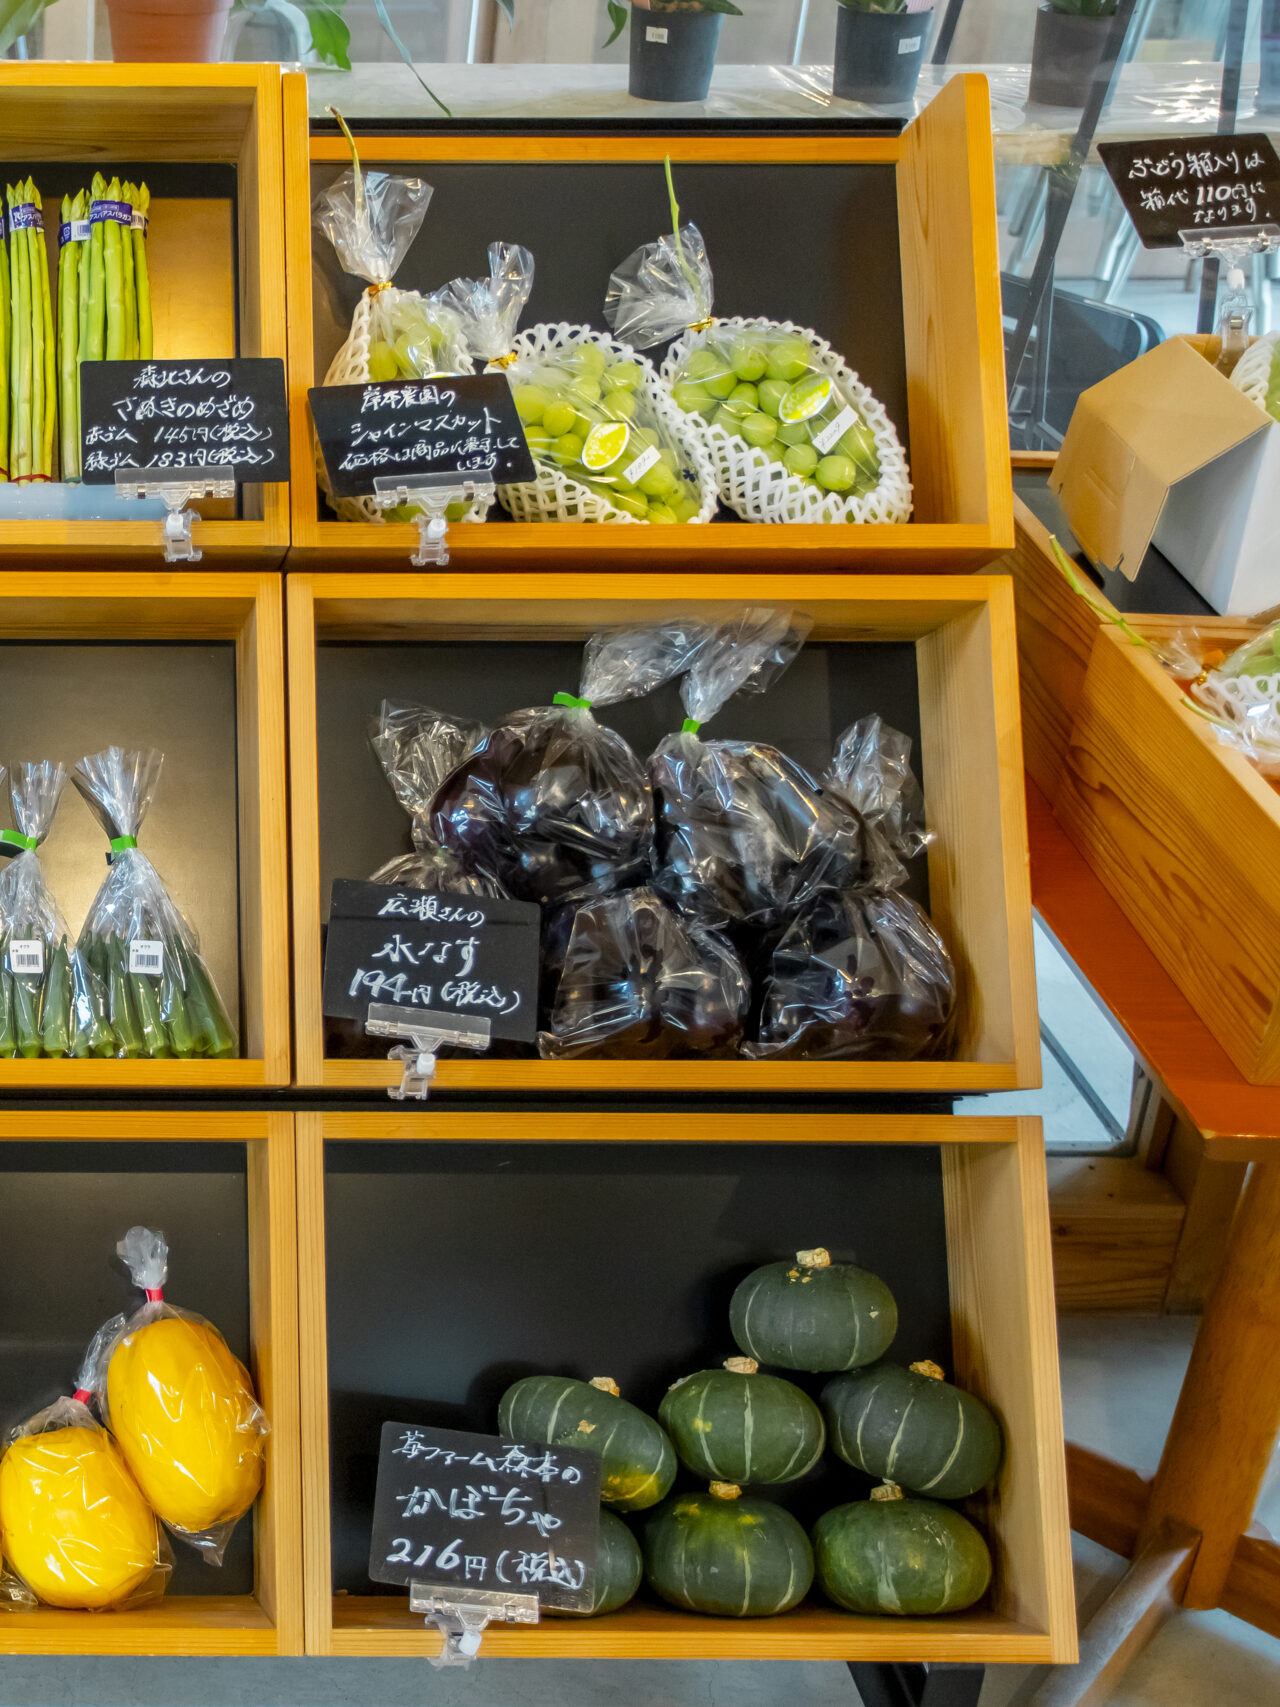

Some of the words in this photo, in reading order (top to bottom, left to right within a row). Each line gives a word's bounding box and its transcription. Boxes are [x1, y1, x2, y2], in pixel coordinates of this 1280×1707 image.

[112, 395, 255, 421] さぬきのめざめ
[350, 406, 501, 447] シャインマスカット
[86, 426, 138, 445] 赤ゴム
[154, 423, 273, 444] 145円(税込)
[85, 450, 139, 471] 緑ゴム
[145, 446, 275, 468] 183円(税込)
[371, 934, 480, 977] 水なす
[348, 968, 521, 1015] 194円(税込)
[386, 1538, 585, 1590] 216円(税込)
